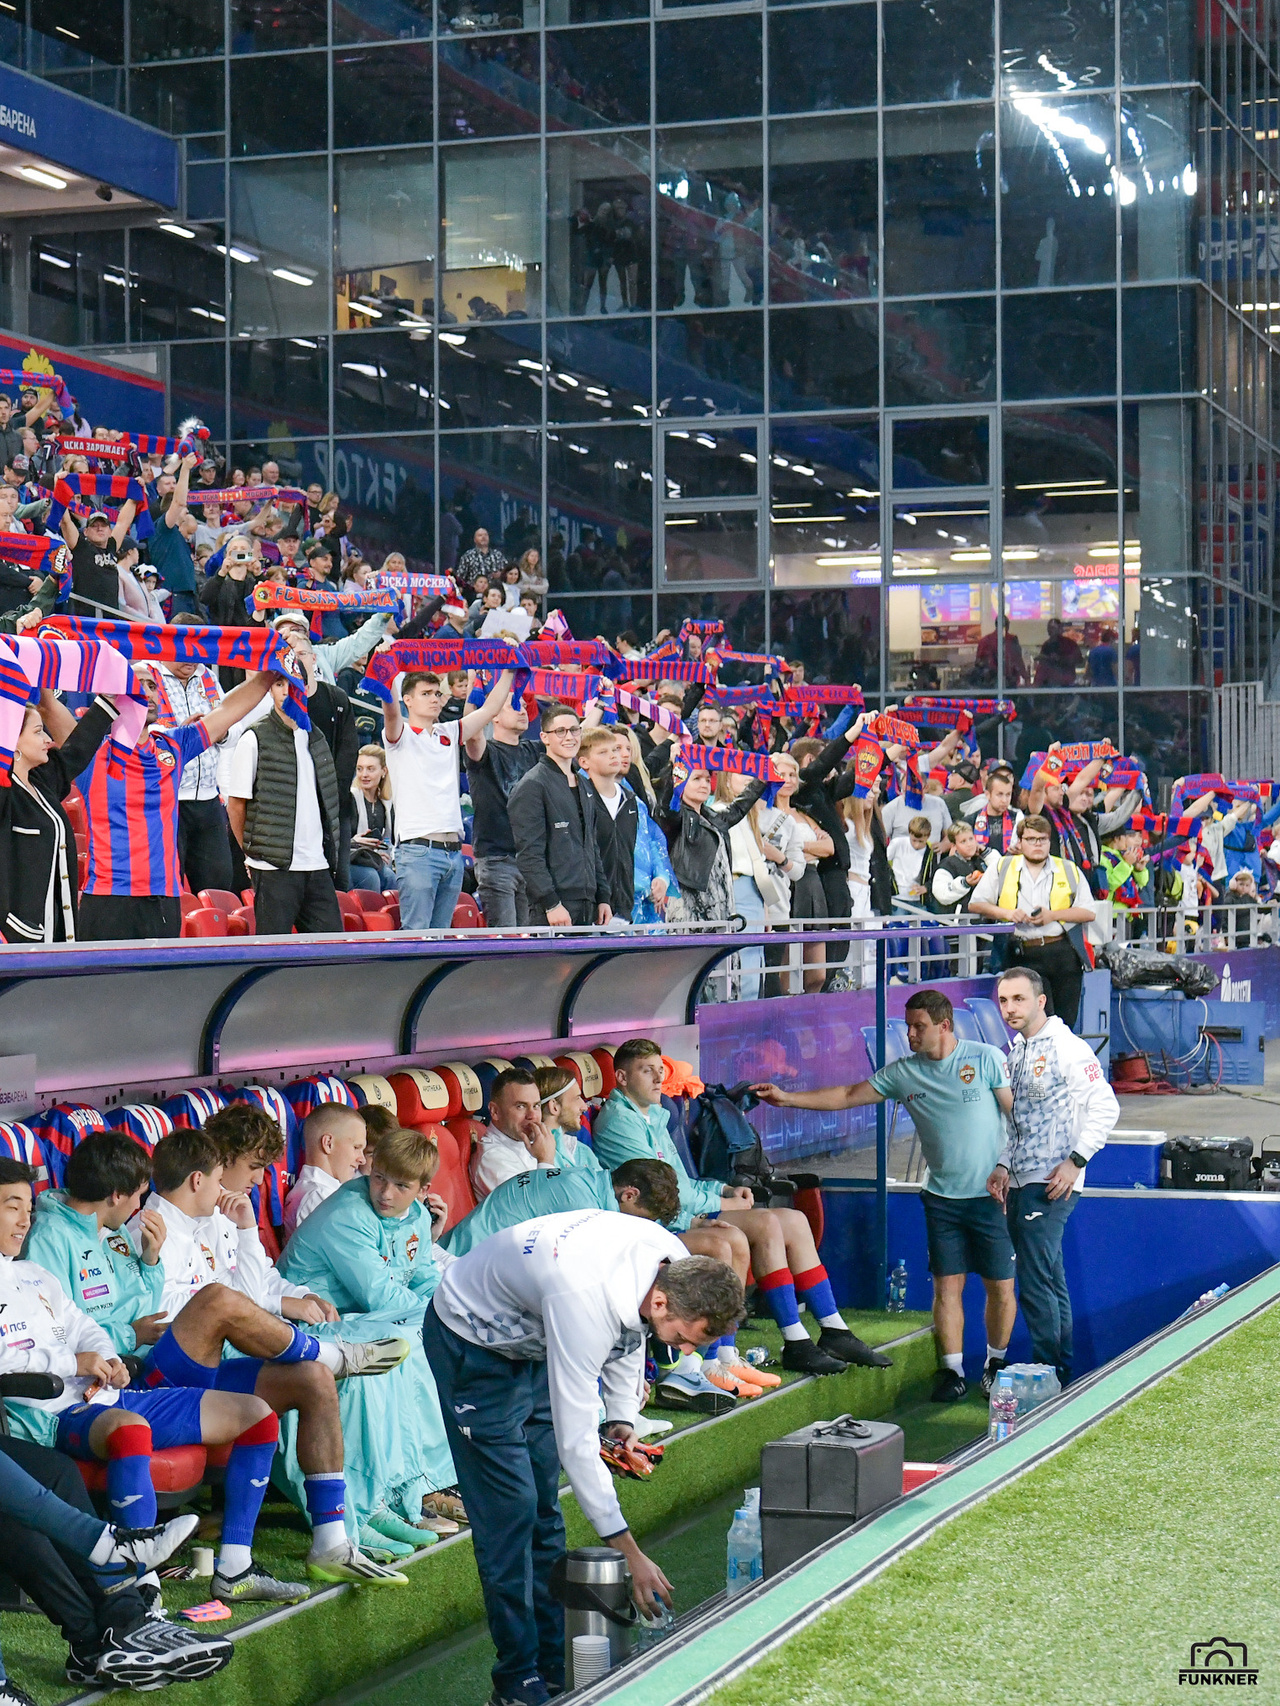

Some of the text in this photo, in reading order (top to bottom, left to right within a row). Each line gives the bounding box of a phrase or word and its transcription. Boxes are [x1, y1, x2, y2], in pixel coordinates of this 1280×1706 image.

[62, 440, 126, 457] ЦСКА ЗАРЯЖАЕТ
[380, 575, 451, 588] ЦСКА МОСКВА
[275, 587, 294, 601] FC
[299, 590, 337, 606] CSKA
[423, 649, 458, 670] ЦСКА
[462, 648, 519, 666] МОСКВА
[545, 671, 577, 698] ЦСКА
[0, 1090, 28, 1105] ВЭБАРЕНА
[1194, 1172, 1225, 1182] joma
[9, 1321, 28, 1333] ПСБ
